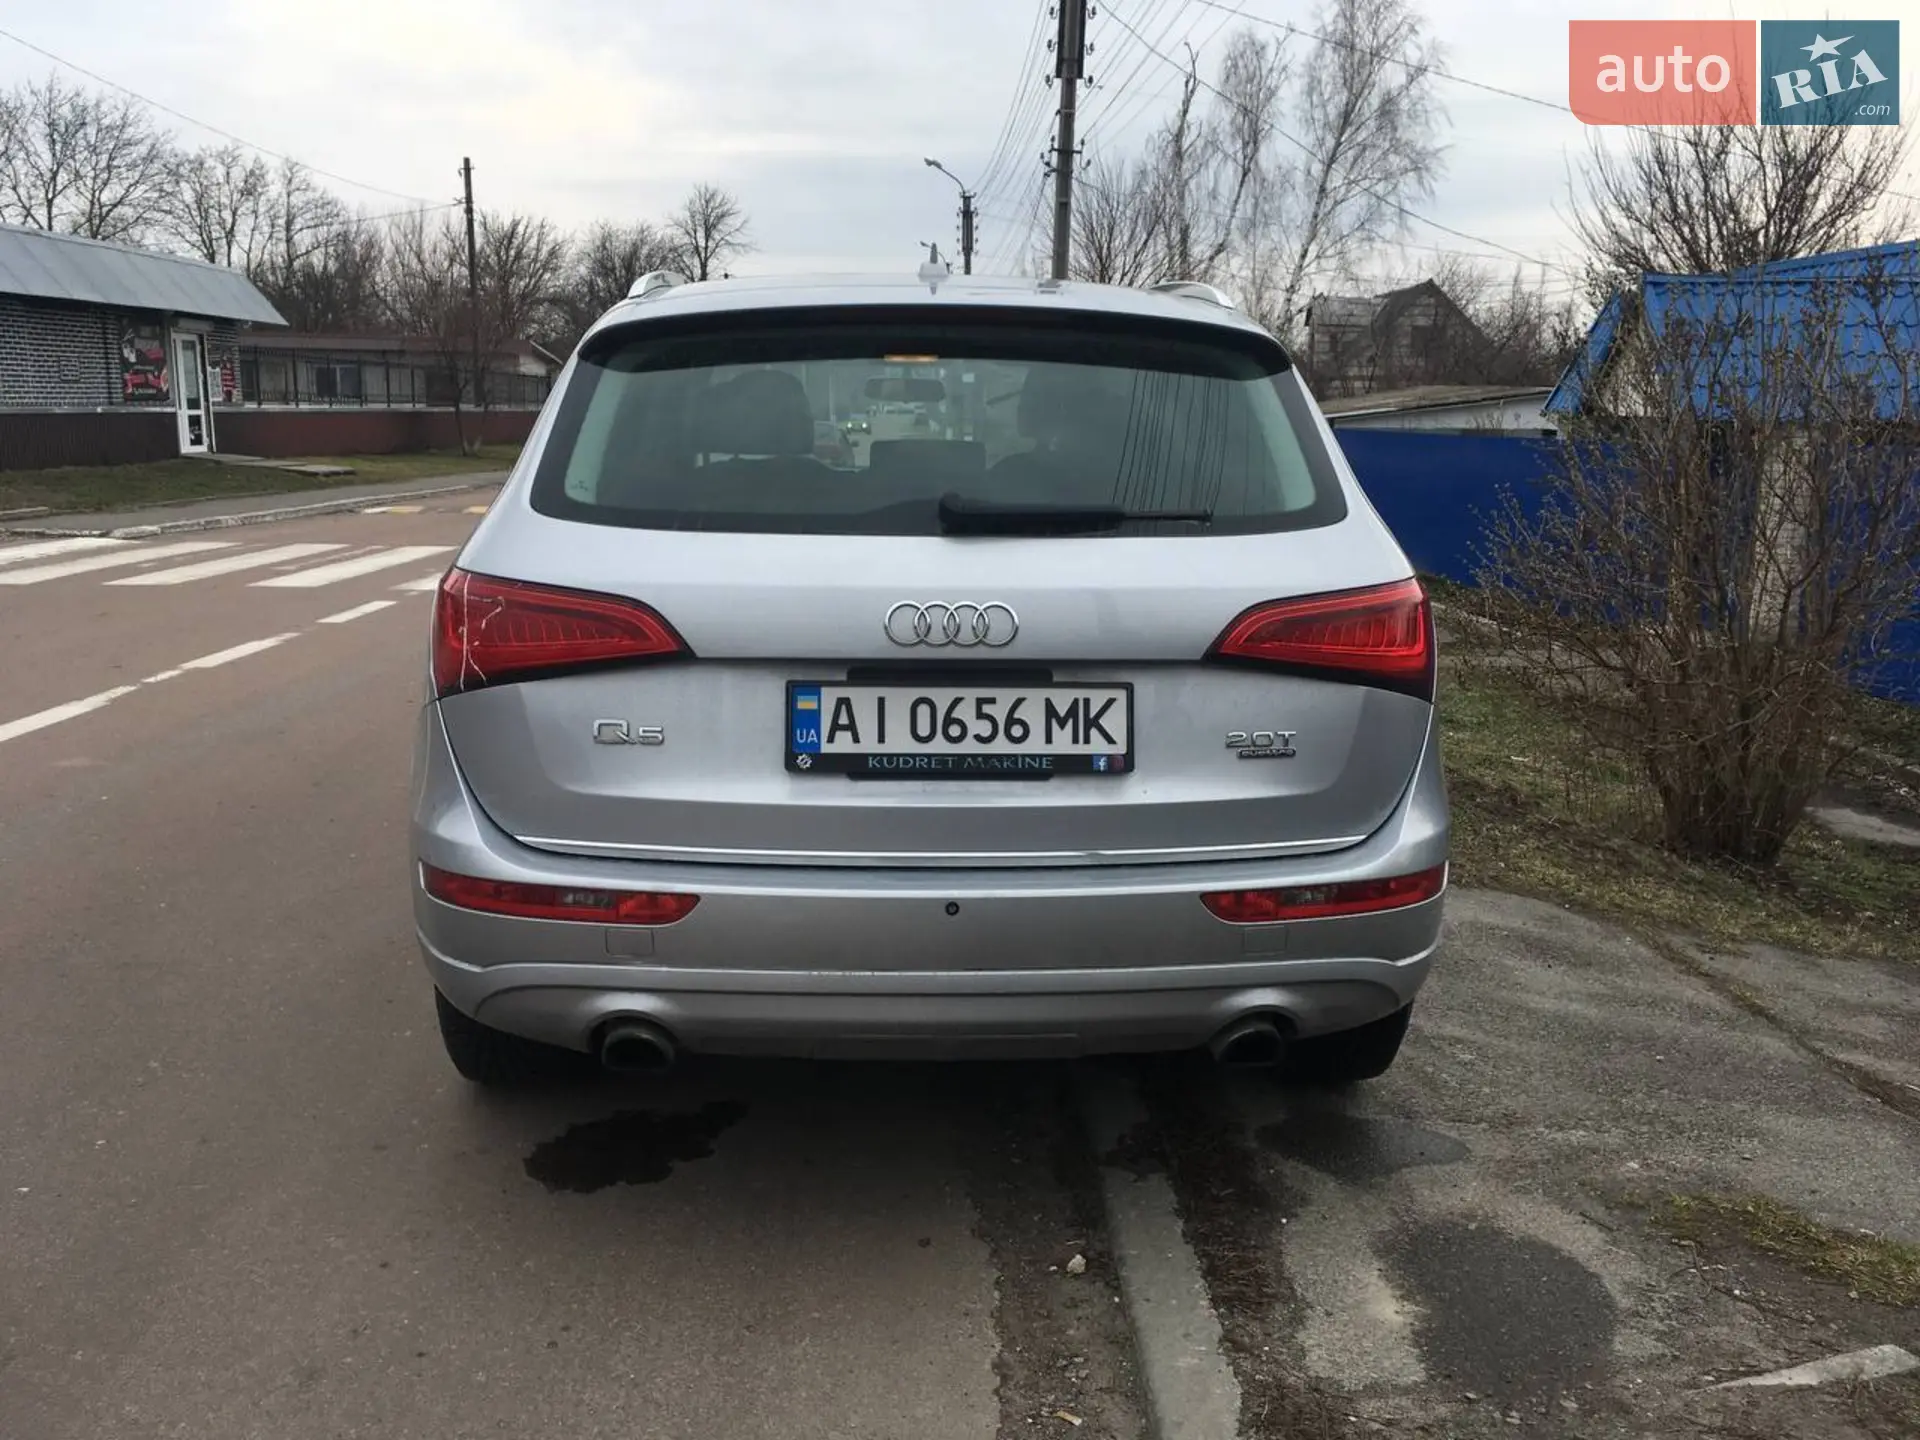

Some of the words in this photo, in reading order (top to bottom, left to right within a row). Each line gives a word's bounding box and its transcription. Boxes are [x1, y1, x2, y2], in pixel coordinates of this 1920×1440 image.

[826, 696, 886, 744] AI
[909, 696, 1031, 744] 0656
[1044, 696, 1118, 745] MK
[592, 719, 665, 745] Q5
[796, 728, 818, 743] UA
[868, 756, 957, 769] KUDRET
